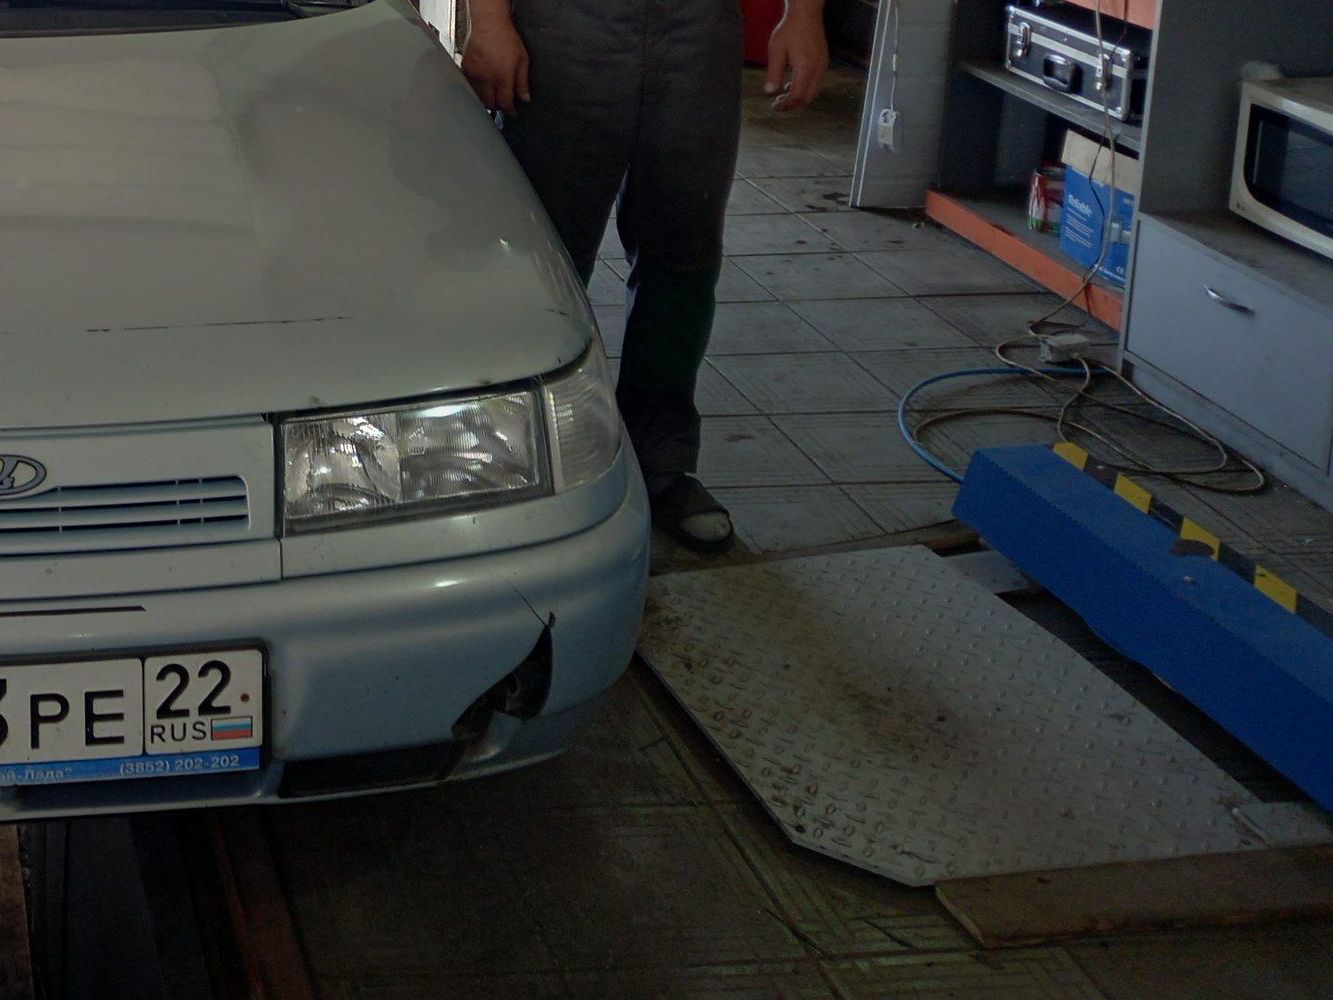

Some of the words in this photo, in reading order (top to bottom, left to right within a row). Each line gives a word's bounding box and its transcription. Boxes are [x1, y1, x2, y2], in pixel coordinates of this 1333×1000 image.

[155, 660, 232, 719] 22
[150, 720, 208, 745] RUS
[174, 755, 241, 771] 202-202
